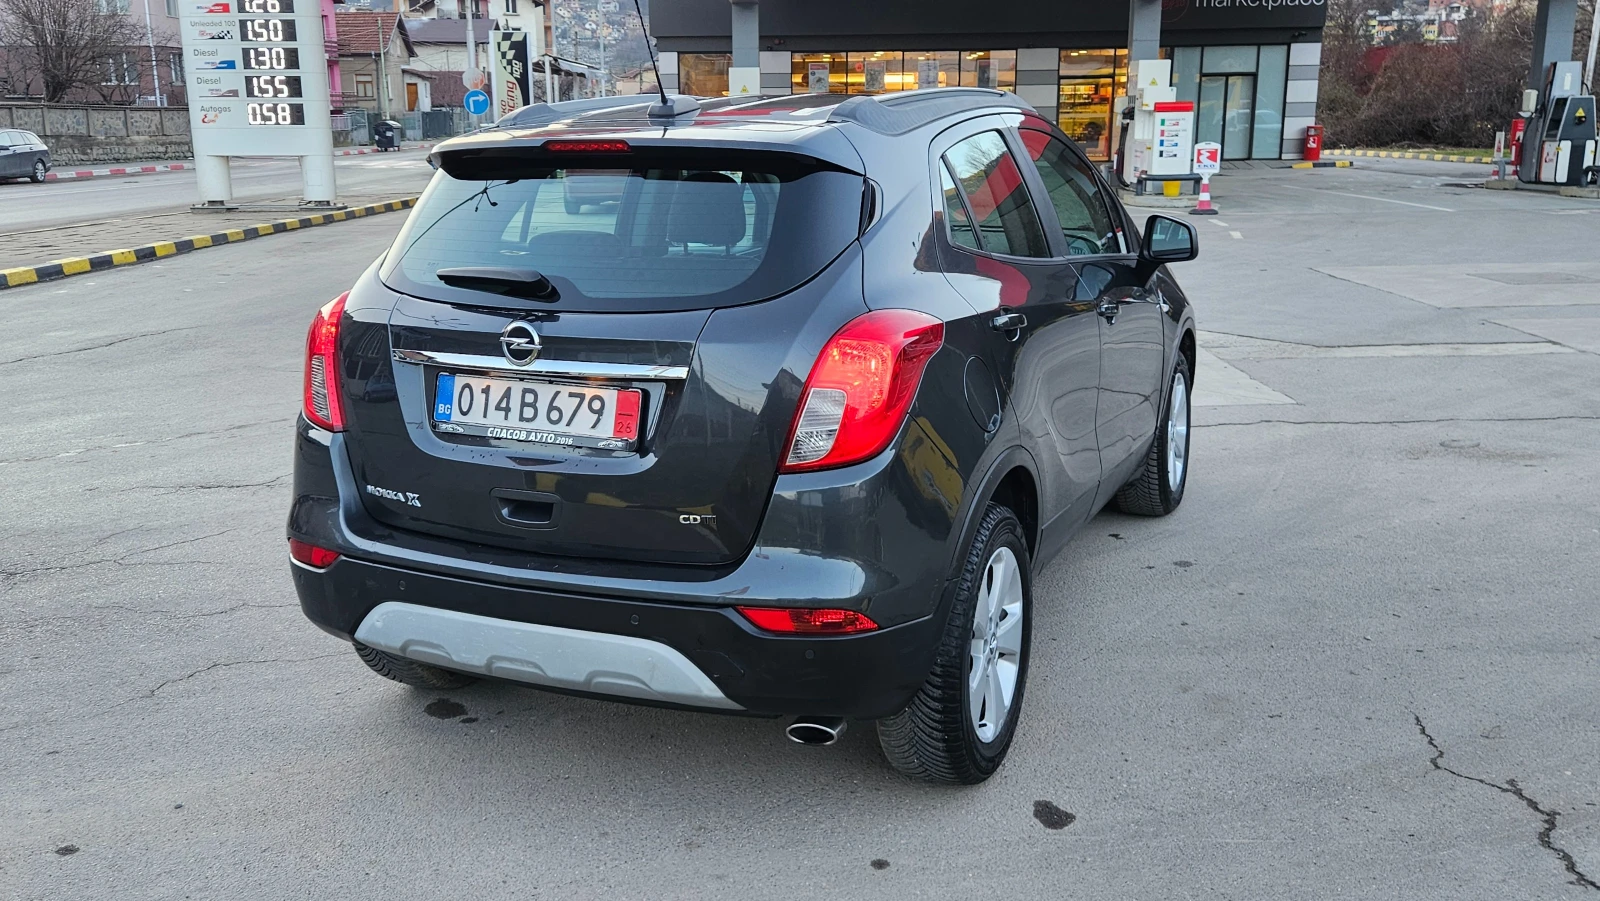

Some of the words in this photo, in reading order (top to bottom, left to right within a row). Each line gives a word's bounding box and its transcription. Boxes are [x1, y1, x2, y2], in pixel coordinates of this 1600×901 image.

[247, 20, 283, 41] 1.50
[193, 48, 218, 57] Diesel
[250, 47, 286, 70] 1.30
[512, 60, 521, 78] 100
[196, 76, 221, 85] Diesel
[252, 76, 289, 98] 1.55
[506, 80, 518, 113] acing
[200, 105, 232, 114] Autogas
[247, 103, 291, 125] 0.58
[438, 403, 451, 415] BG
[457, 382, 606, 430] 014B679
[487, 427, 527, 440] СПАСОВ
[528, 432, 555, 443] АУТО
[556, 436, 574, 445] 2016
[616, 421, 632, 434] 26
[366, 484, 406, 502] MOKKA
[679, 514, 717, 525] CDTI
